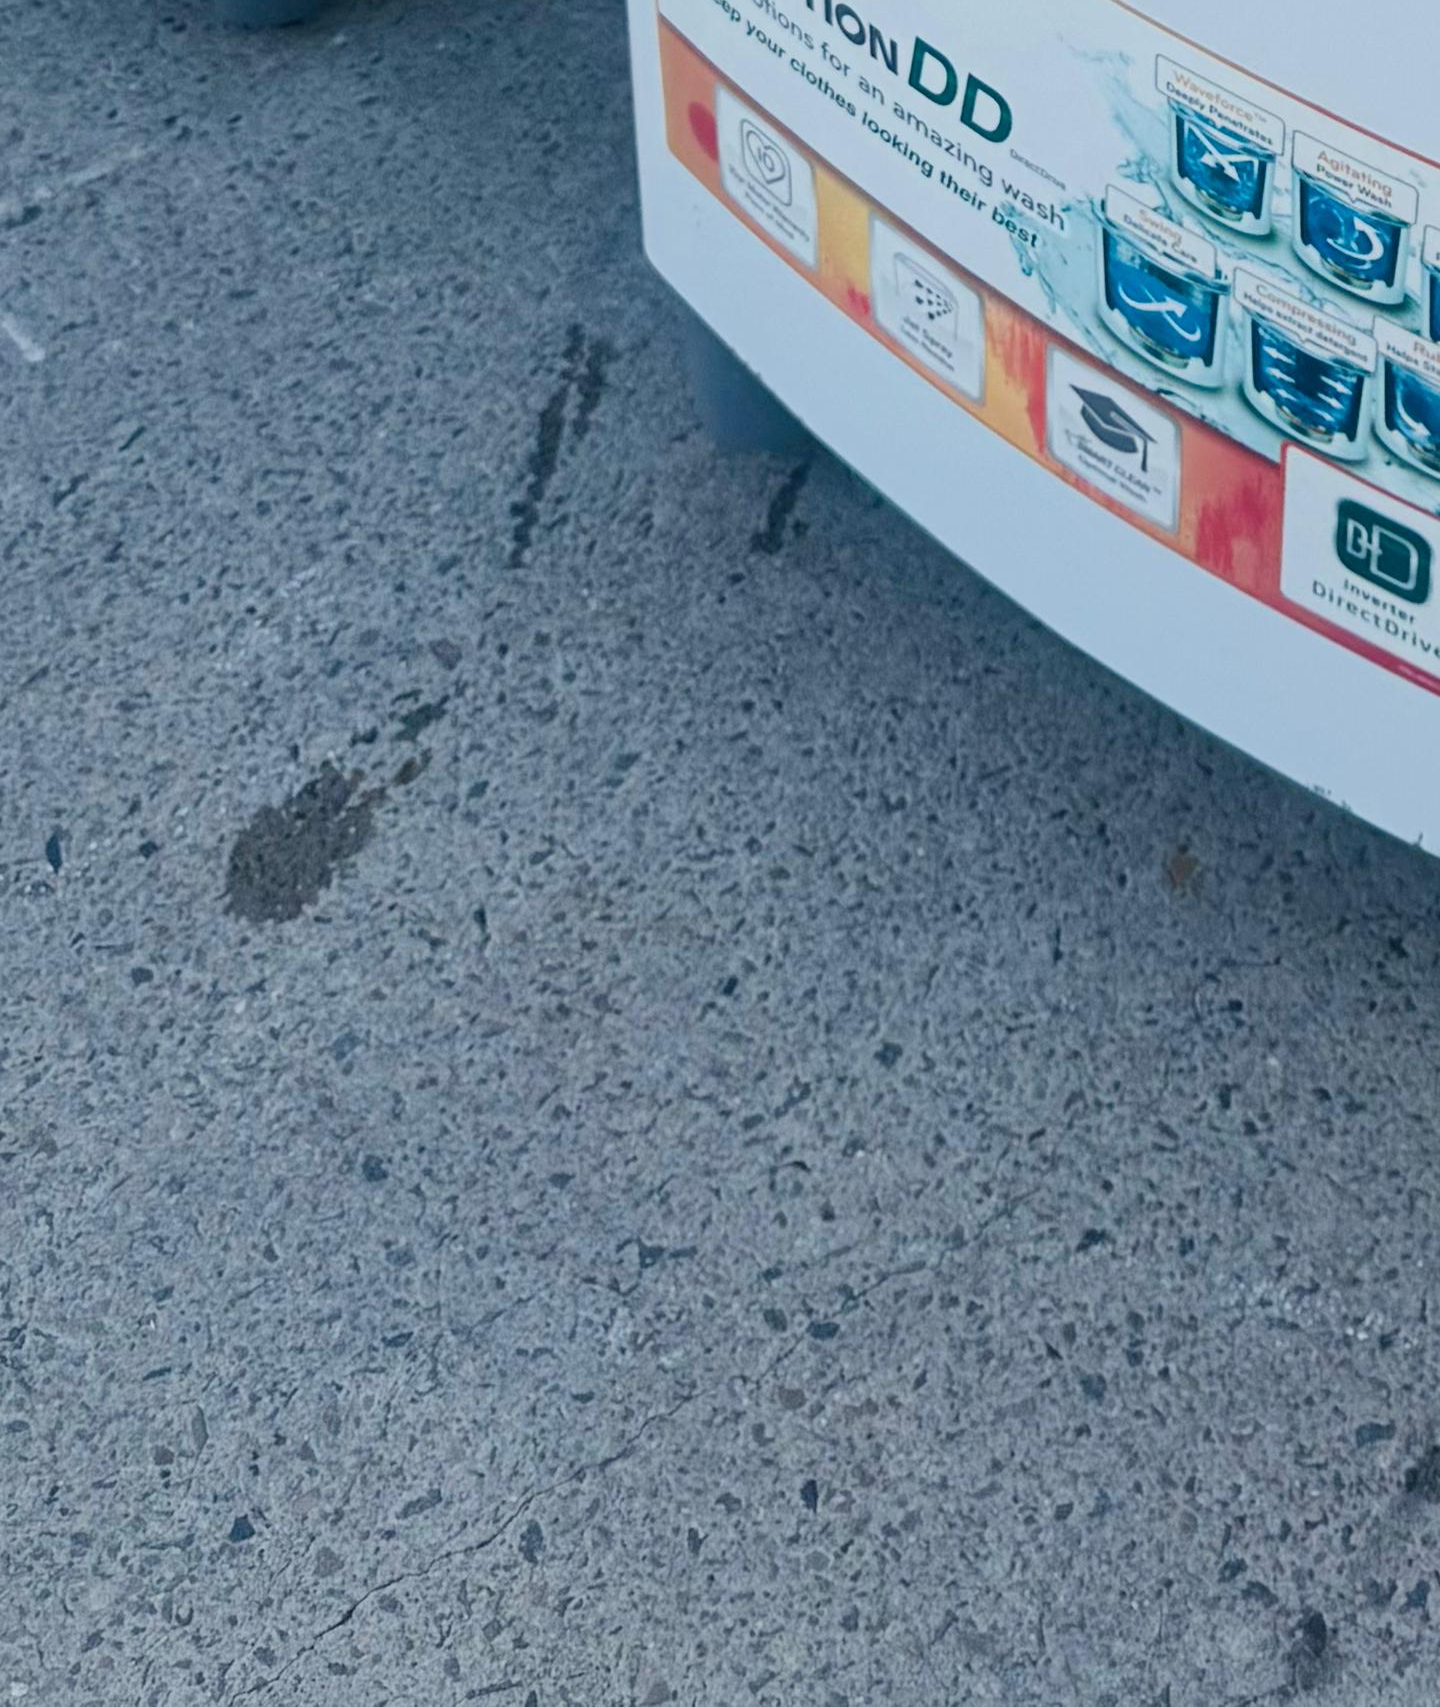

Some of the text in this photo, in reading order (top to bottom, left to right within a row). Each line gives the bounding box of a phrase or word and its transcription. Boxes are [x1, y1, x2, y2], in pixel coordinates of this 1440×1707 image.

[907, 34, 1013, 144] DD
[1165, 81, 1274, 147] Deeply Penetrates
[745, 19, 787, 59] your
[789, 56, 857, 117] clothes
[861, 110, 935, 179] looking
[939, 168, 988, 211] their
[991, 204, 1040, 249] best
[820, 40, 851, 77] for
[858, 75, 885, 106] an
[892, 100, 994, 187] amazing
[1000, 177, 1066, 232] wash
[1315, 163, 1393, 209] Power Wash
[1316, 149, 1393, 199] Agitating
[1122, 213, 1199, 264] Delicate Care
[1137, 208, 1183, 245] Swing
[1242, 291, 1273, 315] Helps
[1274, 305, 1314, 336] extract
[1255, 283, 1357, 347] Compressing
[1385, 342, 1420, 368] Helps
[1342, 577, 1416, 625] Inverter
